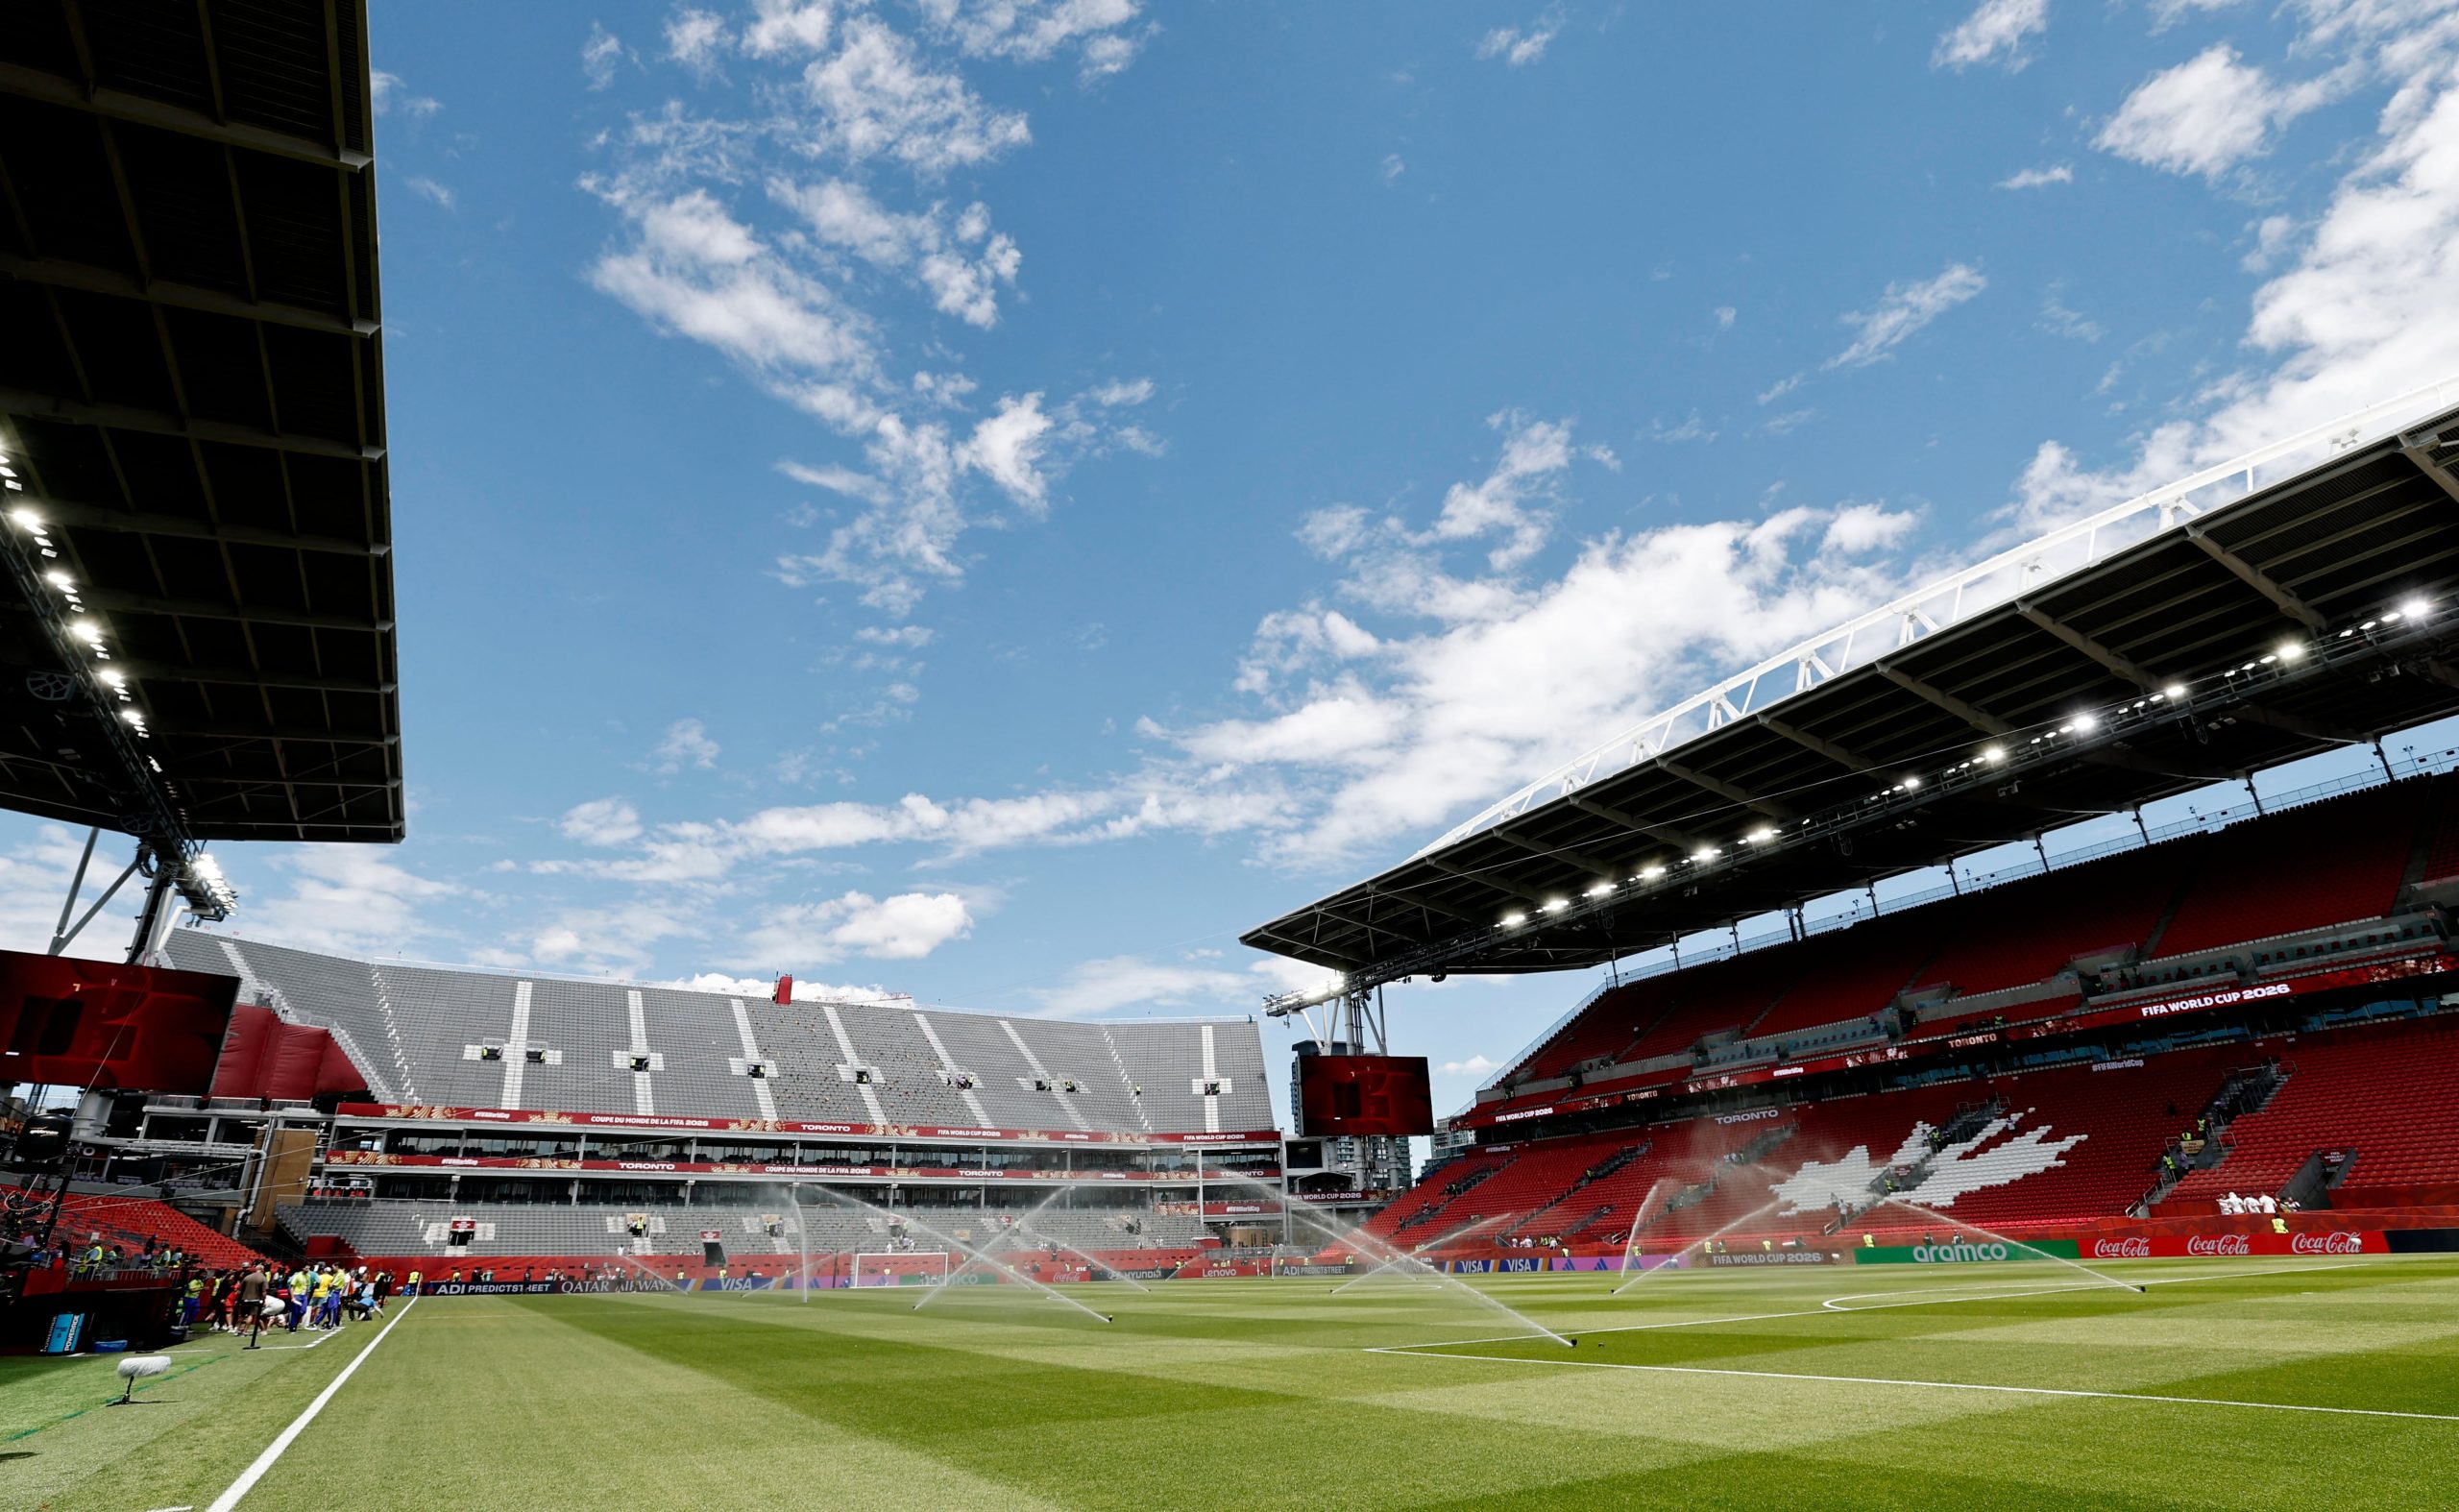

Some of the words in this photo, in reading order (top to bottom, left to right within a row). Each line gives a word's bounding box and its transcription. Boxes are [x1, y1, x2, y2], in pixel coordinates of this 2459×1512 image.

[2142, 1005, 2168, 1016] FIFA
[2169, 997, 2214, 1012] WORLD
[2215, 992, 2240, 1004] CUP
[2242, 984, 2290, 999] 2026
[1948, 1034, 1997, 1047] TORONTO
[2092, 1060, 2144, 1072] #FIFAWorldCup
[1627, 1090, 1658, 1101] TORONTO
[1507, 1112, 1523, 1121] WORLD
[1535, 1108, 1553, 1116] 2026
[1715, 1110, 1778, 1124] TORONTO
[2095, 1237, 2151, 1257] Coca-Cola
[2187, 1235, 2250, 1256] Coca-Cola
[2292, 1232, 2362, 1254] Coca-Cola
[1714, 1256, 1733, 1264] FIFA
[1734, 1255, 1765, 1263] WORLD
[1766, 1254, 1786, 1262] CUP
[1787, 1253, 1821, 1262] 2026
[1913, 1243, 2008, 1262] aramco
[1283, 1266, 1300, 1276] ADI
[1460, 1260, 1484, 1273] VISA
[1506, 1259, 1531, 1272] VISA
[1053, 1272, 1081, 1282] Coca-Cola
[1203, 1268, 1237, 1277] Lenovo
[436, 1284, 465, 1294] ADI
[561, 1280, 609, 1294] QATAR
[720, 1278, 752, 1290] VISA
